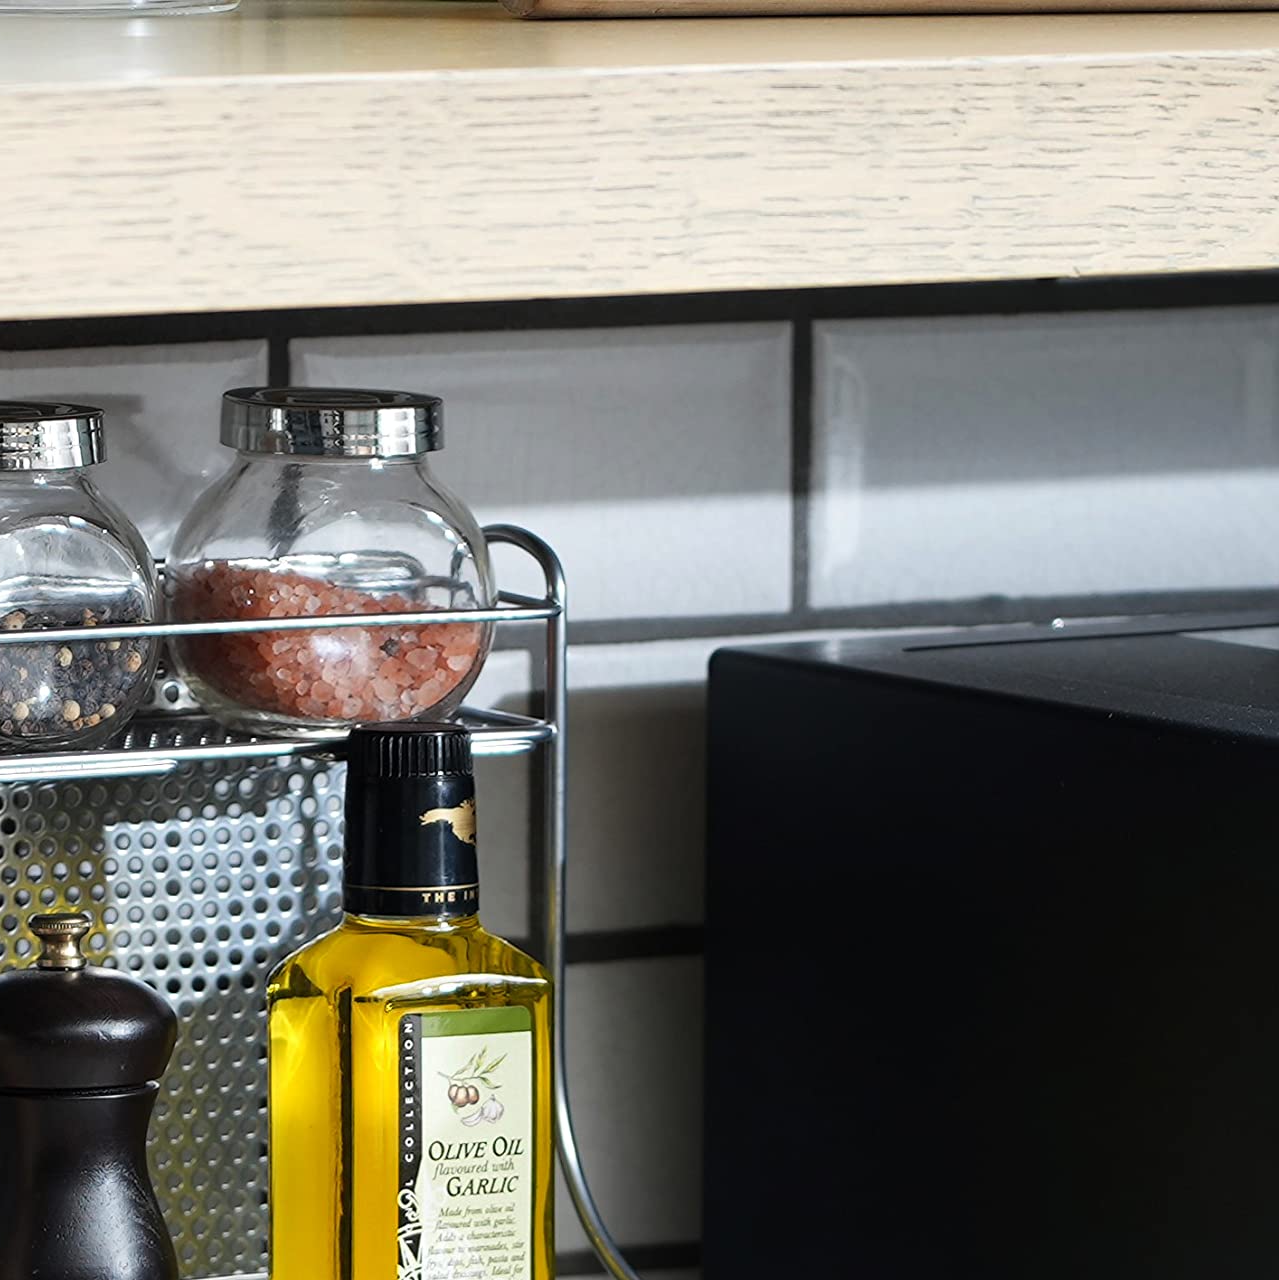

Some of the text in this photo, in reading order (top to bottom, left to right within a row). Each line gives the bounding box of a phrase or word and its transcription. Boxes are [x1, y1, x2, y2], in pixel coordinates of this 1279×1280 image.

[422, 891, 456, 903] THE
[404, 1022, 415, 1163] COLLECTION
[428, 1136, 524, 1161] OLIVE OIL
[432, 1158, 515, 1180] flavoured with
[446, 1176, 519, 1197] GARLIC
[438, 1206, 462, 1218] Made
[463, 1205, 483, 1219] from
